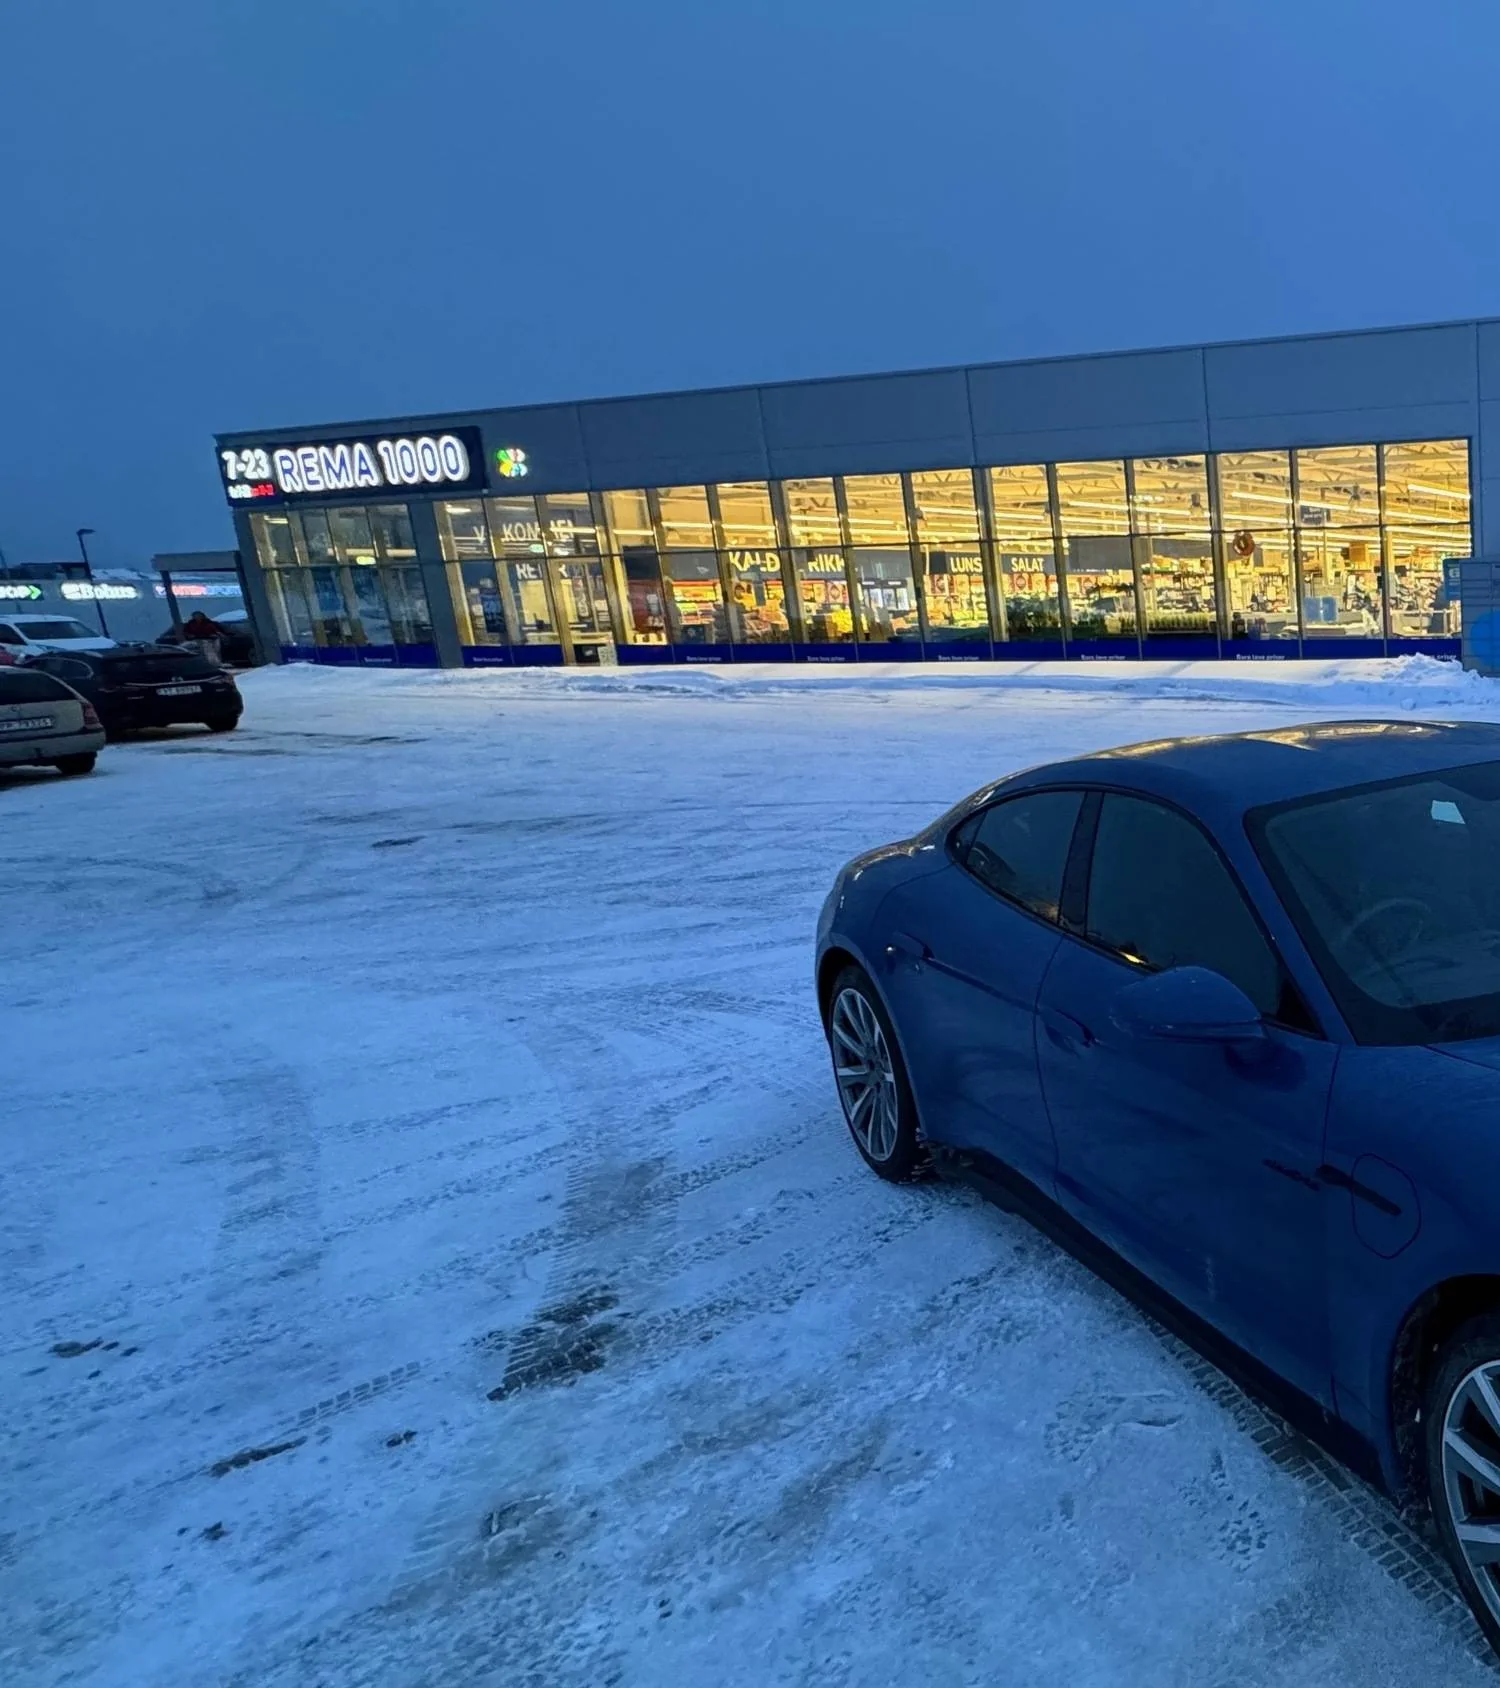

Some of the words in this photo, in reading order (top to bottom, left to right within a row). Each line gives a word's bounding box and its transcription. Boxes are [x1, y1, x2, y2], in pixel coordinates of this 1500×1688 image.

[221, 448, 271, 480] 7-23
[274, 443, 380, 493] REMA
[378, 435, 469, 485] 1000
[1012, 557, 1044, 572] SALAT
